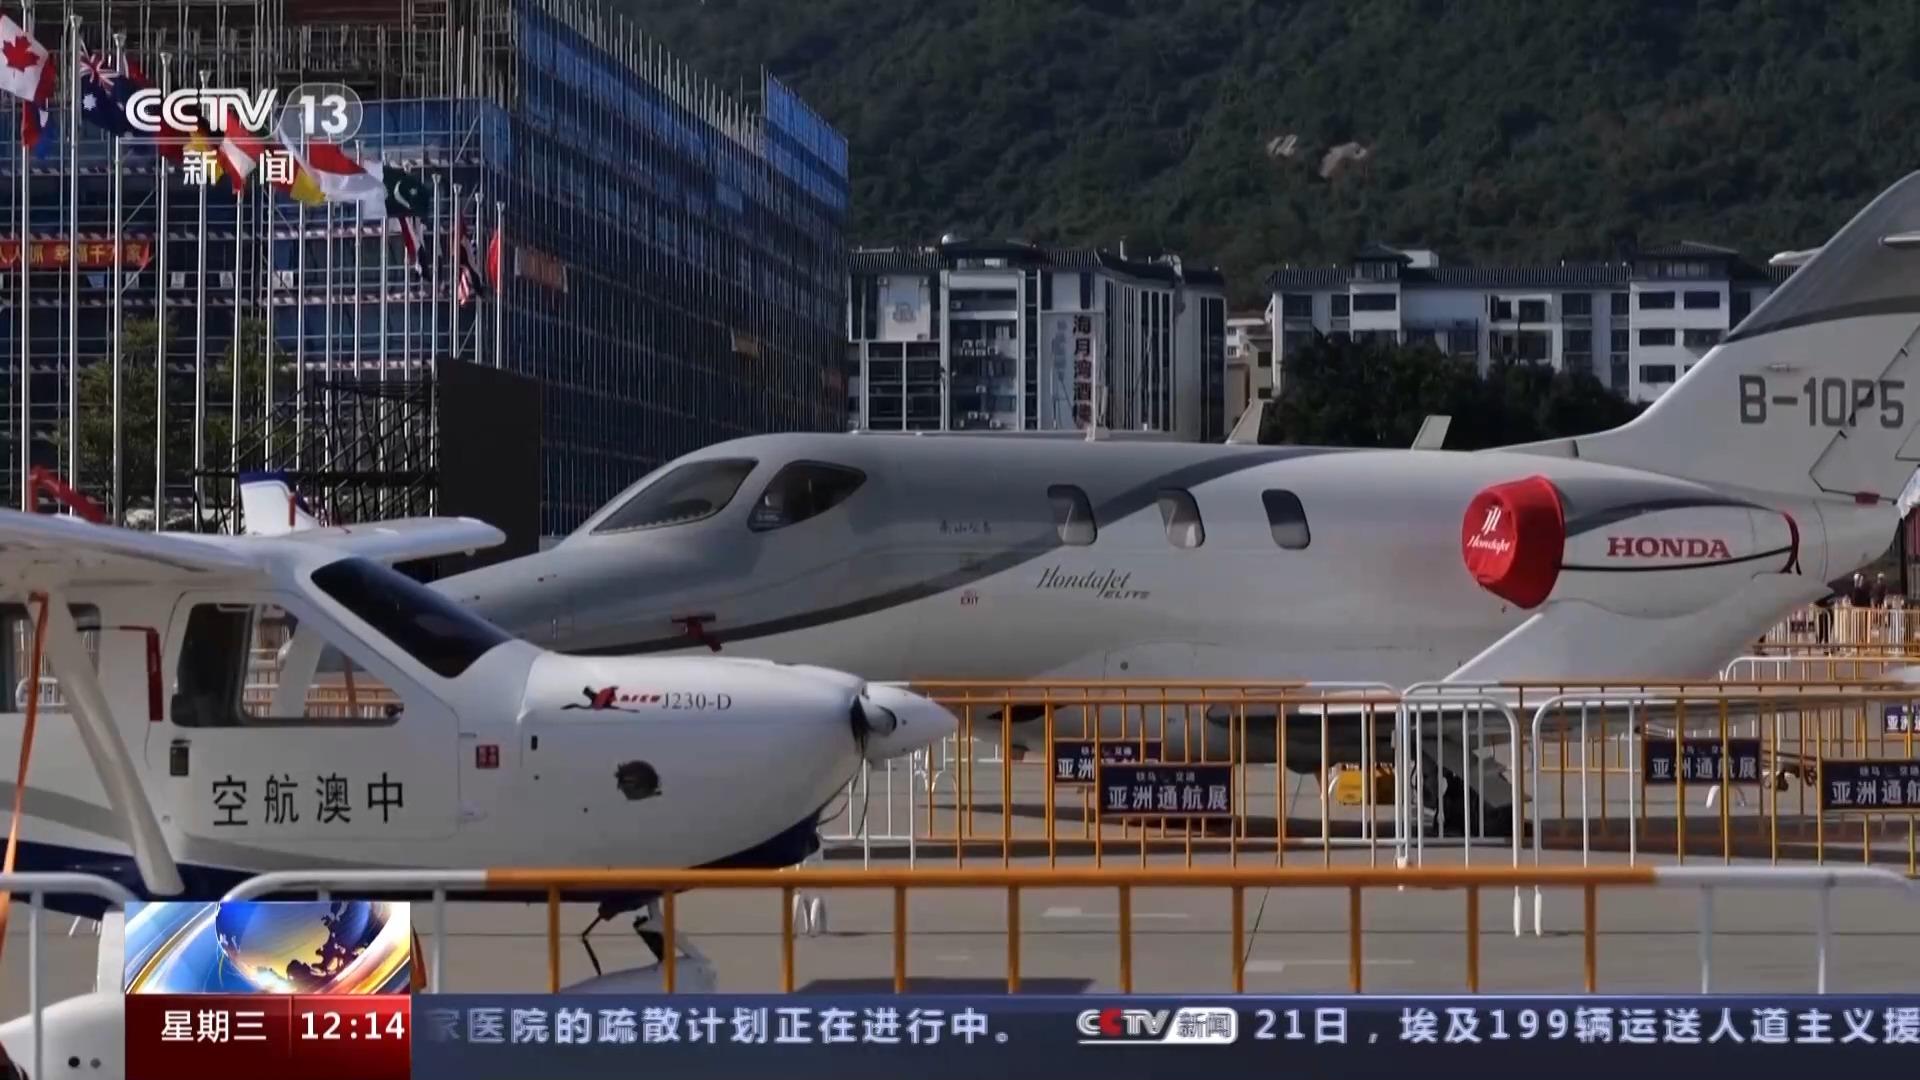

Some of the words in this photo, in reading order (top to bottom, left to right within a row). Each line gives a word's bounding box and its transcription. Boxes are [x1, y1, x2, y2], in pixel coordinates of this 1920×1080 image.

[1739, 374, 1905, 429] B-10P5
[1606, 536, 1732, 559] HONDA
[661, 693, 732, 711] J230-D
[1107, 784, 1228, 811] 亚洲通航展
